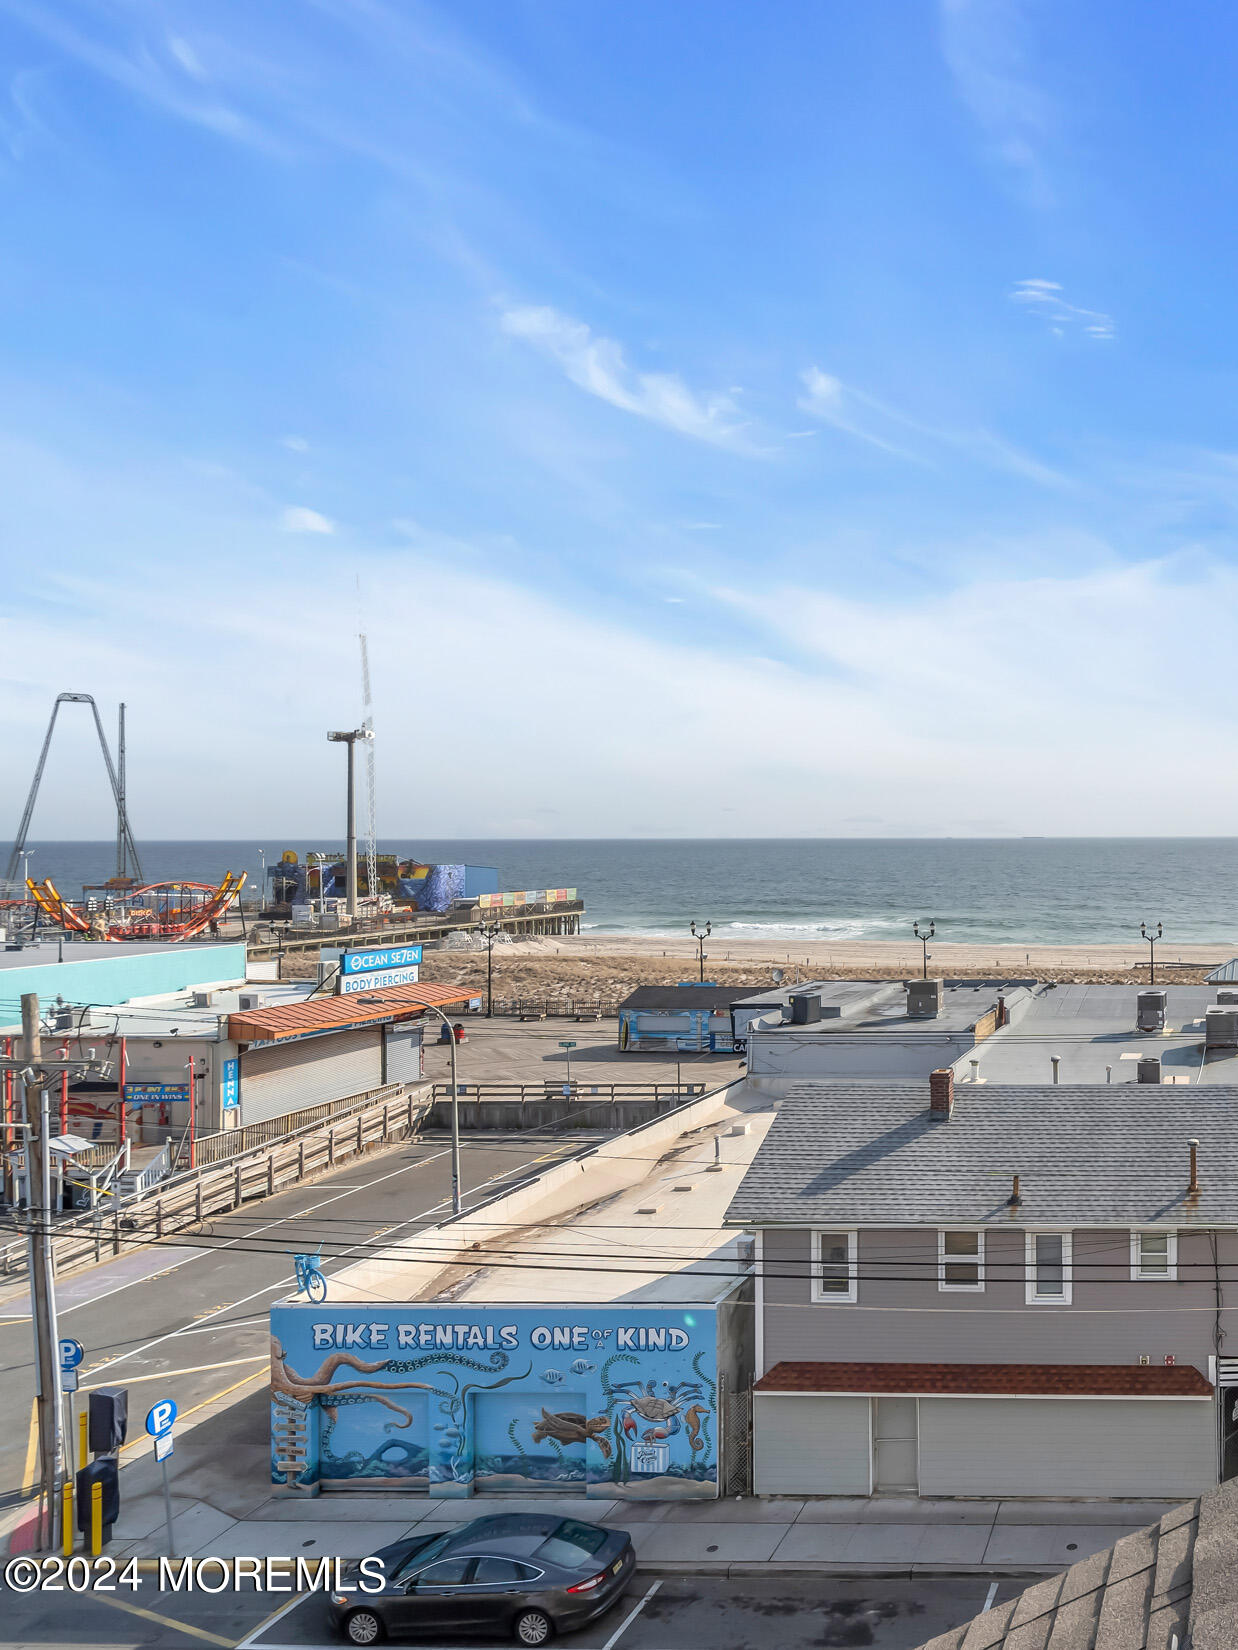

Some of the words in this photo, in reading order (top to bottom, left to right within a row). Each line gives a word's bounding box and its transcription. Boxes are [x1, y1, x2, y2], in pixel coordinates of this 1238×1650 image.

[351, 953, 388, 970] OCEAN
[391, 949, 419, 964] SE7EN
[345, 978, 373, 993] BODY
[374, 971, 415, 987] PIERCING
[227, 1061, 235, 1106] HENNA
[311, 1323, 390, 1350] BIKE
[397, 1324, 519, 1351] RENTALS
[530, 1325, 590, 1352] ONE
[591, 1329, 613, 1340] OF
[595, 1340, 605, 1349] A
[617, 1326, 690, 1351] KIND
[60, 1342, 76, 1365] P
[153, 1402, 171, 1434] P
